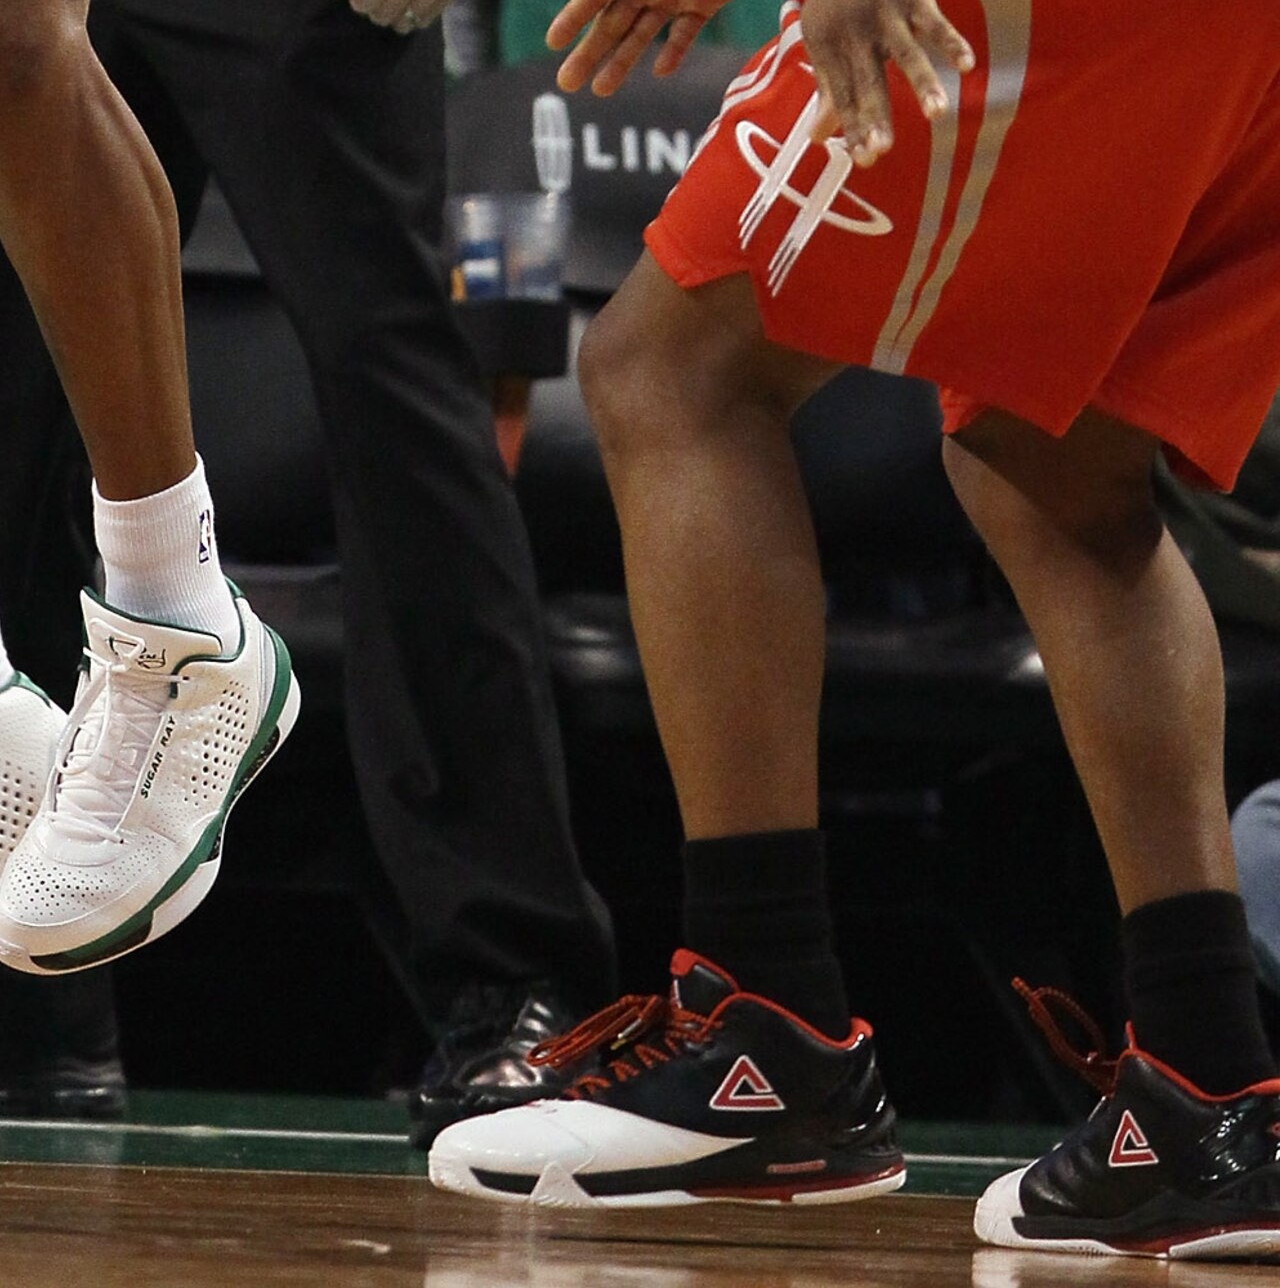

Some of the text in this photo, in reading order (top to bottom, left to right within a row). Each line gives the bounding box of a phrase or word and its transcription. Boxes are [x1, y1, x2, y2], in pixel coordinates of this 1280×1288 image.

[581, 122, 692, 175] LIN
[139, 715, 178, 800] SUGAR RAY
